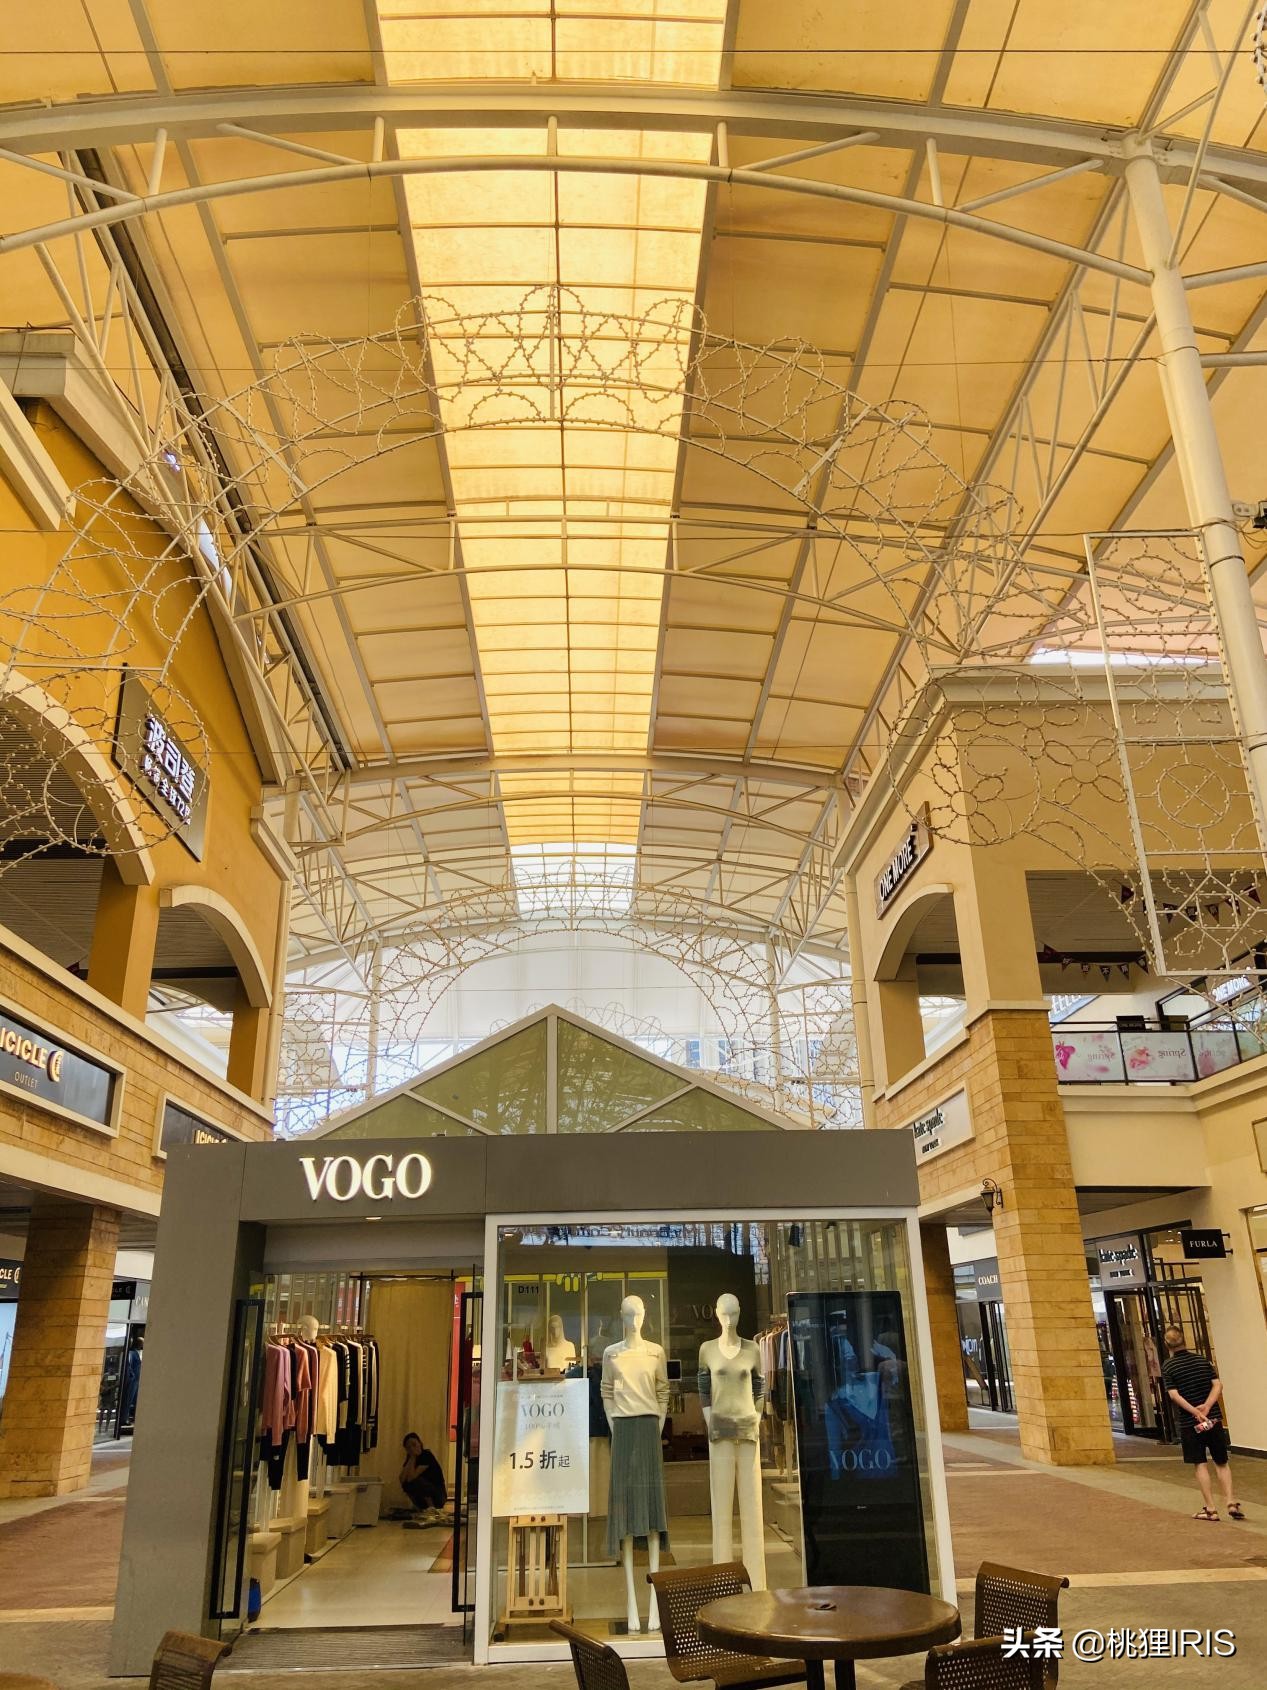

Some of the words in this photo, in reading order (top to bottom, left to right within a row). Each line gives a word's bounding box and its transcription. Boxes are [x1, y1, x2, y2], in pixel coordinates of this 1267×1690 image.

[880, 866, 894, 900] ONE
[892, 834, 914, 885] MORE
[14, 1071, 38, 1089] OUTLET
[299, 1153, 432, 1201] VOGO
[1189, 1240, 1218, 1248] FURLA
[978, 1274, 999, 1285] COACH
[518, 1285, 540, 1294] D111
[521, 1403, 565, 1417] VOGO
[510, 1451, 534, 1470] 1.5
[539, 1449, 571, 1470] 折起
[829, 1449, 891, 1470] VOGO
